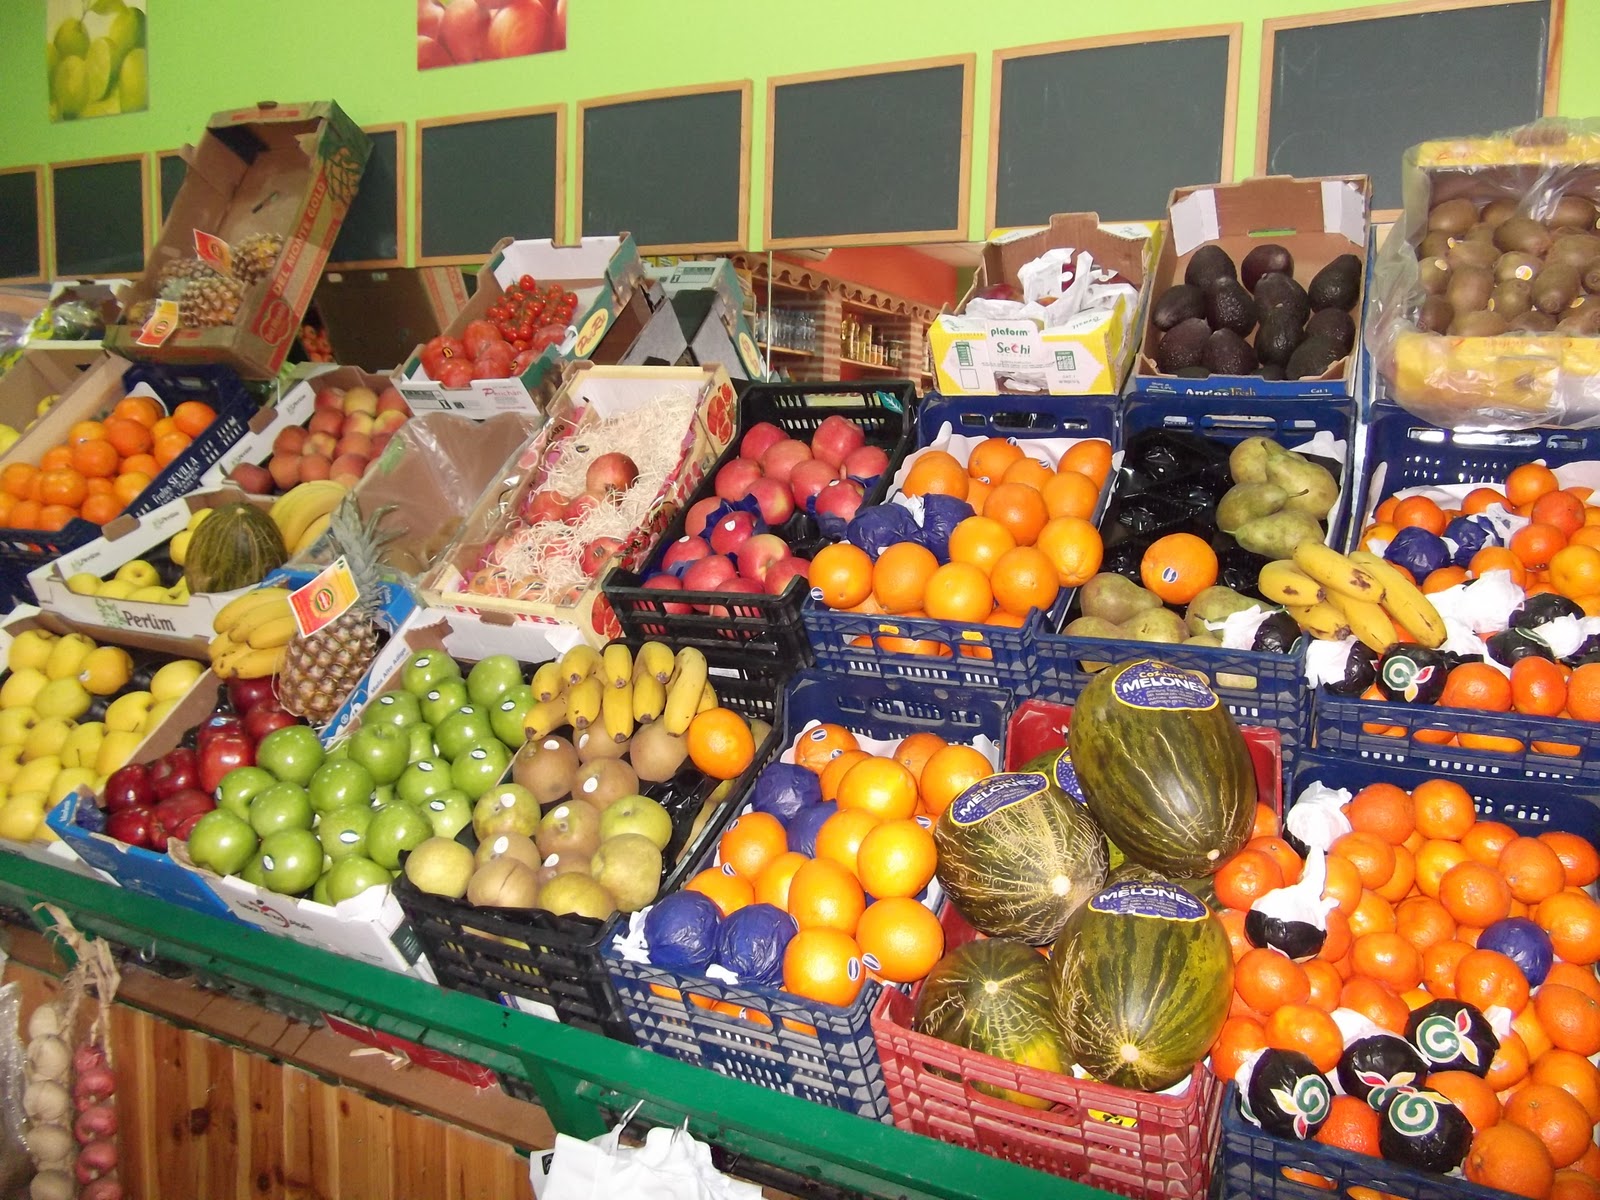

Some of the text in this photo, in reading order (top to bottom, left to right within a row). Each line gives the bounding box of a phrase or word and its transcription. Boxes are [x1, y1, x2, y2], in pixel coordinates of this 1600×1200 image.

[273, 266, 291, 295] DEL
[286, 219, 313, 268] MONTE
[307, 182, 325, 218] GOLD
[990, 327, 1028, 337] plaform
[168, 456, 199, 485] SEVILLA
[122, 610, 176, 632] Perlim
[455, 605, 560, 626] FUTES
[393, 647, 407, 666] Adige
[1122, 677, 1208, 695] MELONES
[959, 779, 1039, 816] MELONES
[1099, 888, 1198, 909] MELONES
